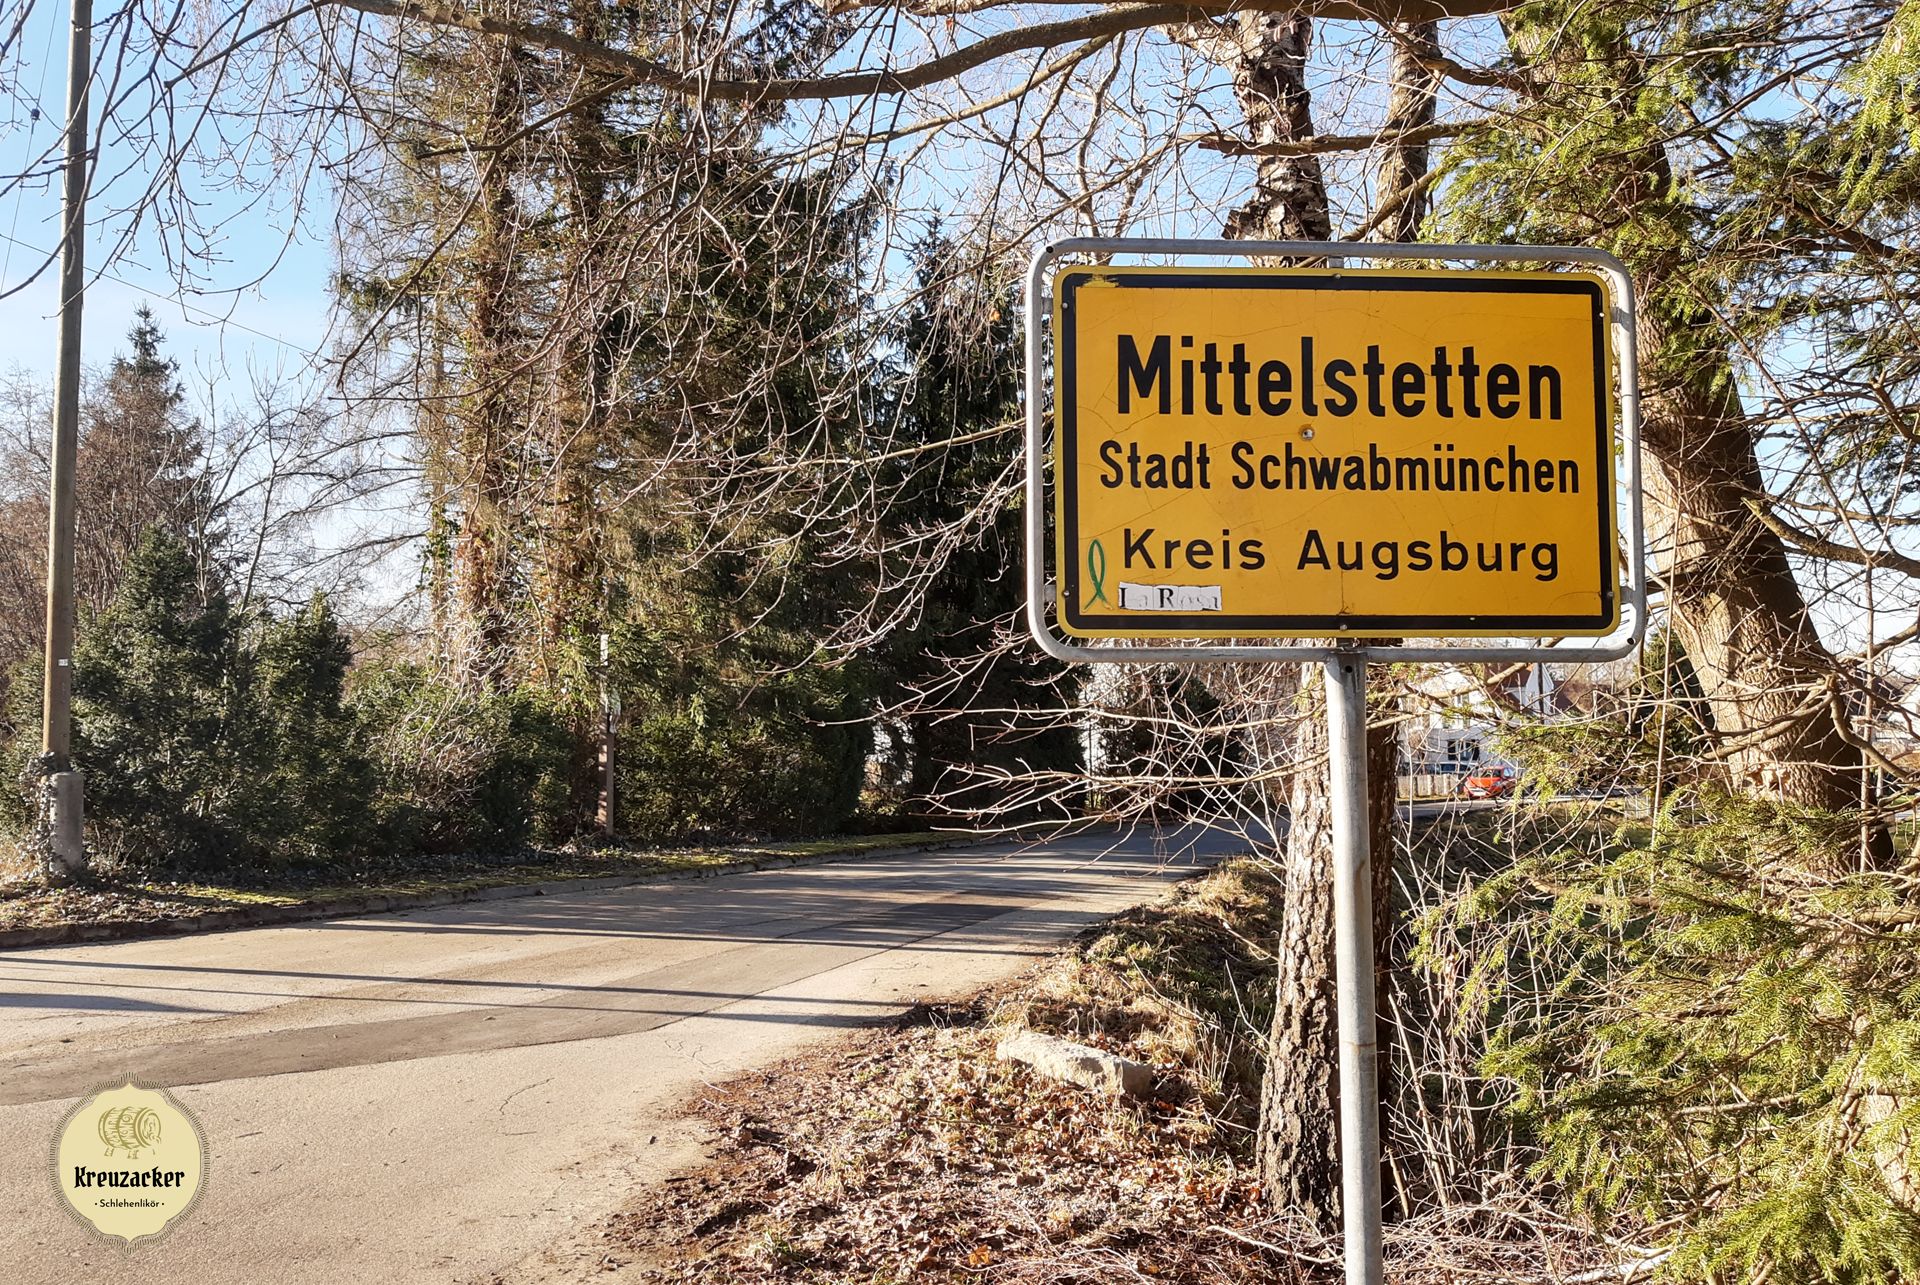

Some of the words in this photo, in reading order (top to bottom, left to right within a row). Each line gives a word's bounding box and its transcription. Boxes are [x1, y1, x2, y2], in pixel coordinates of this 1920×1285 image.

[1117, 335, 1562, 420] Mittelstetten
[1100, 440, 1211, 489] Stadt
[1232, 442, 1579, 493] Schwabmünchen
[1124, 529, 1266, 570] Kreis
[1297, 530, 1559, 581] Augsburg
